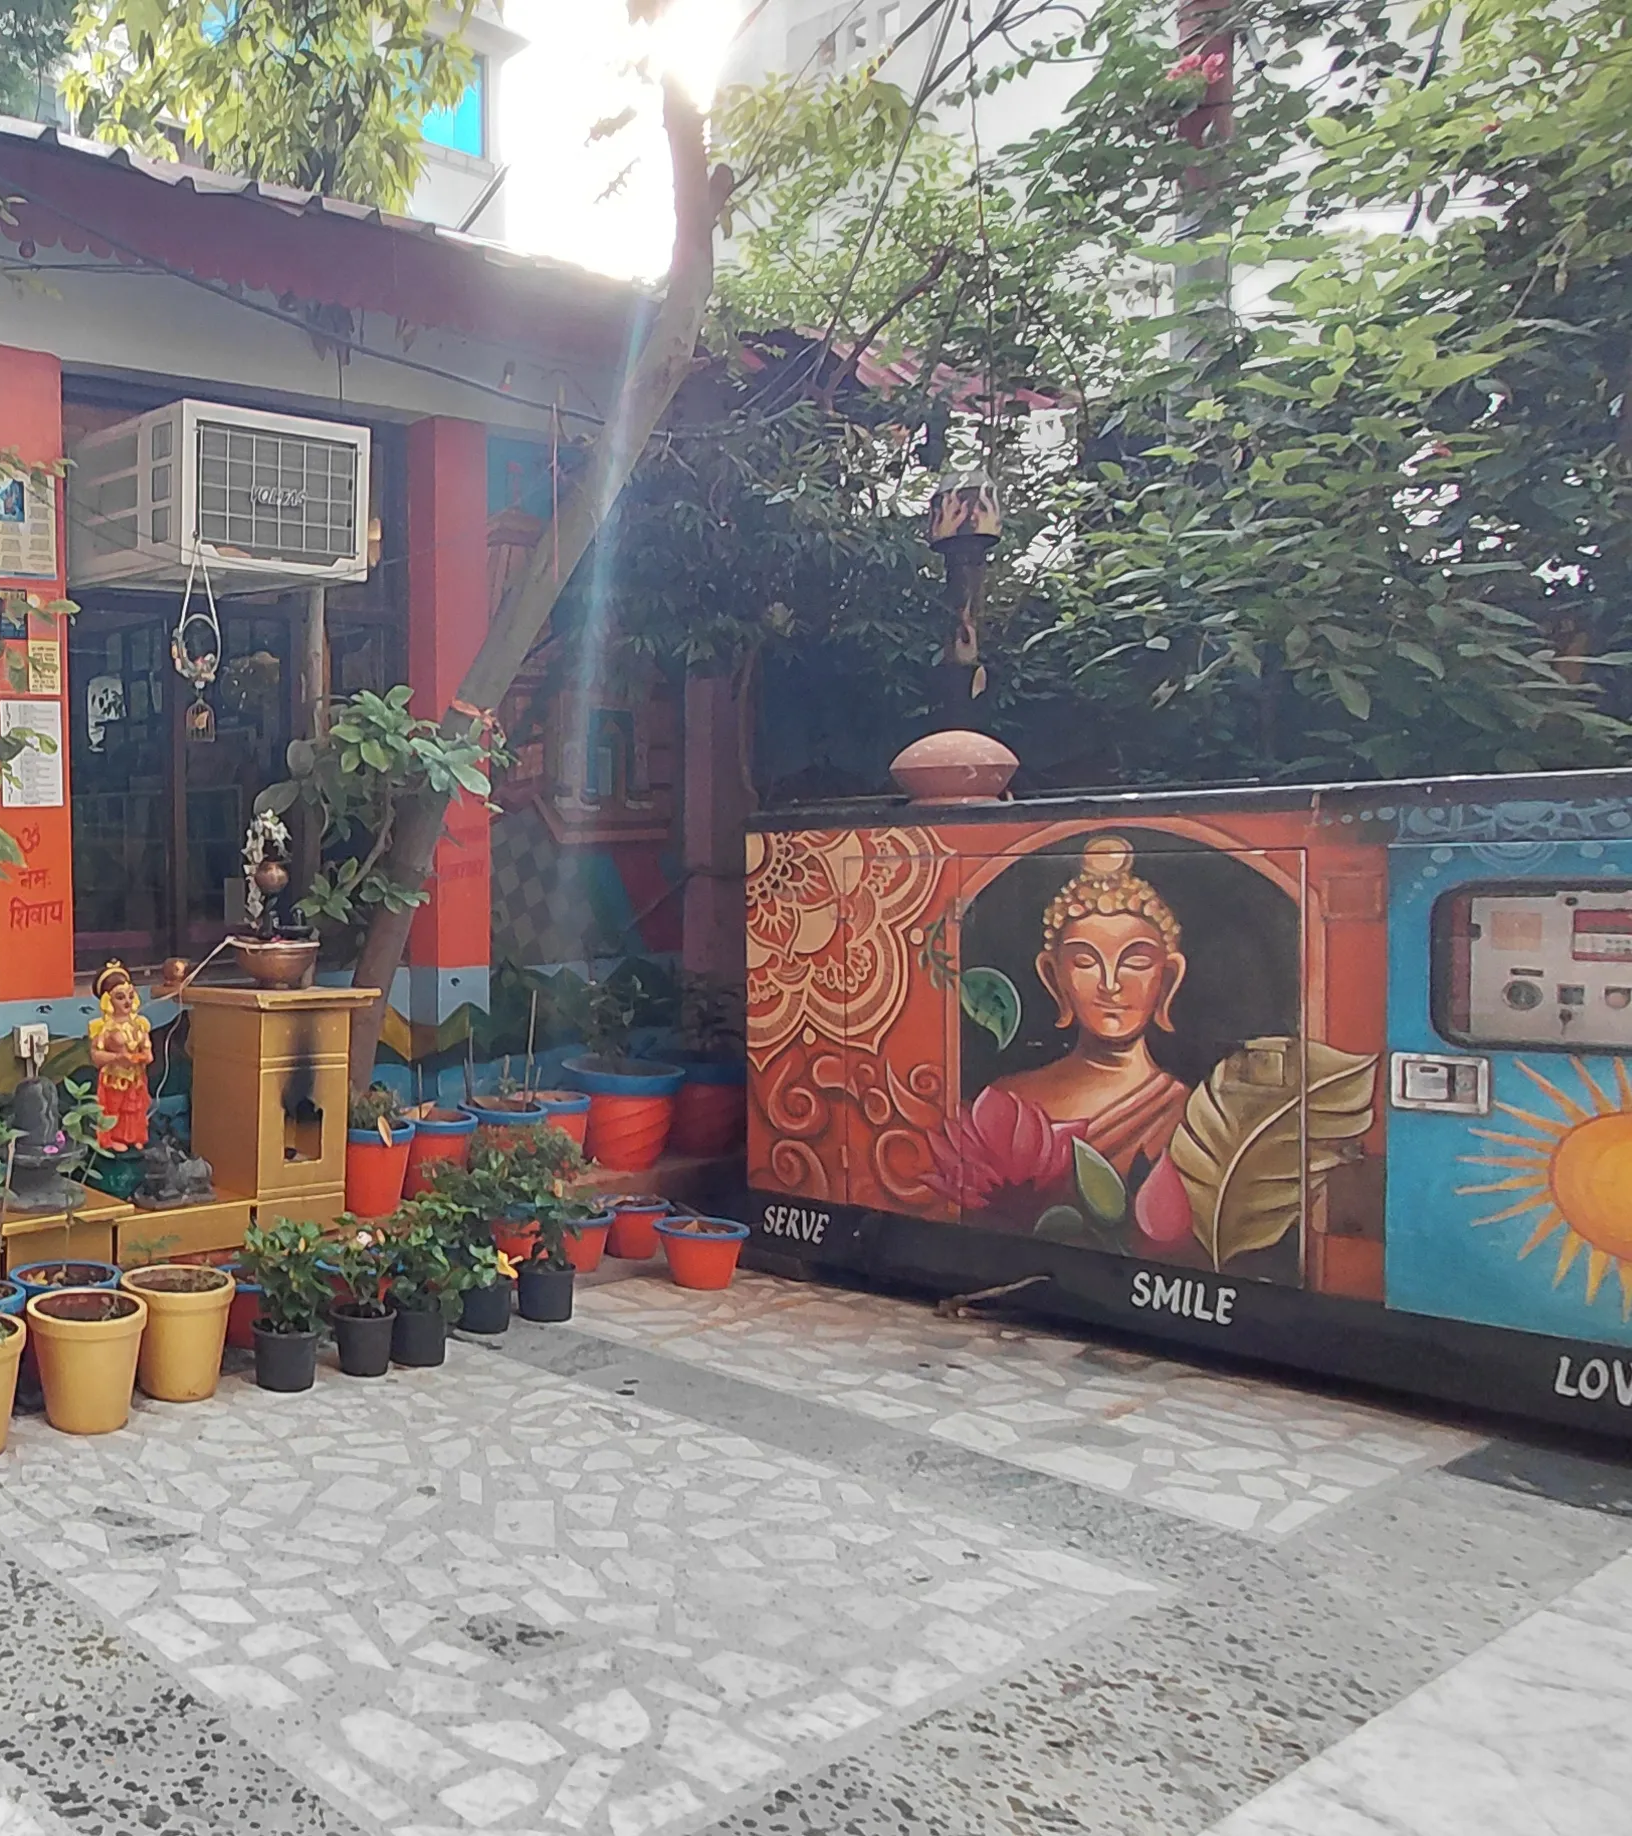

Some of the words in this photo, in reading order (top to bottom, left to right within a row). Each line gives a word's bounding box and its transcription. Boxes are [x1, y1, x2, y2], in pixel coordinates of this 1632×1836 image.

[250, 484, 308, 507] VOLTAS
[18, 868, 52, 890] नमः
[9, 896, 64, 931] शिवाय
[763, 1205, 830, 1245] SERVE
[1131, 1271, 1237, 1325] SMILE
